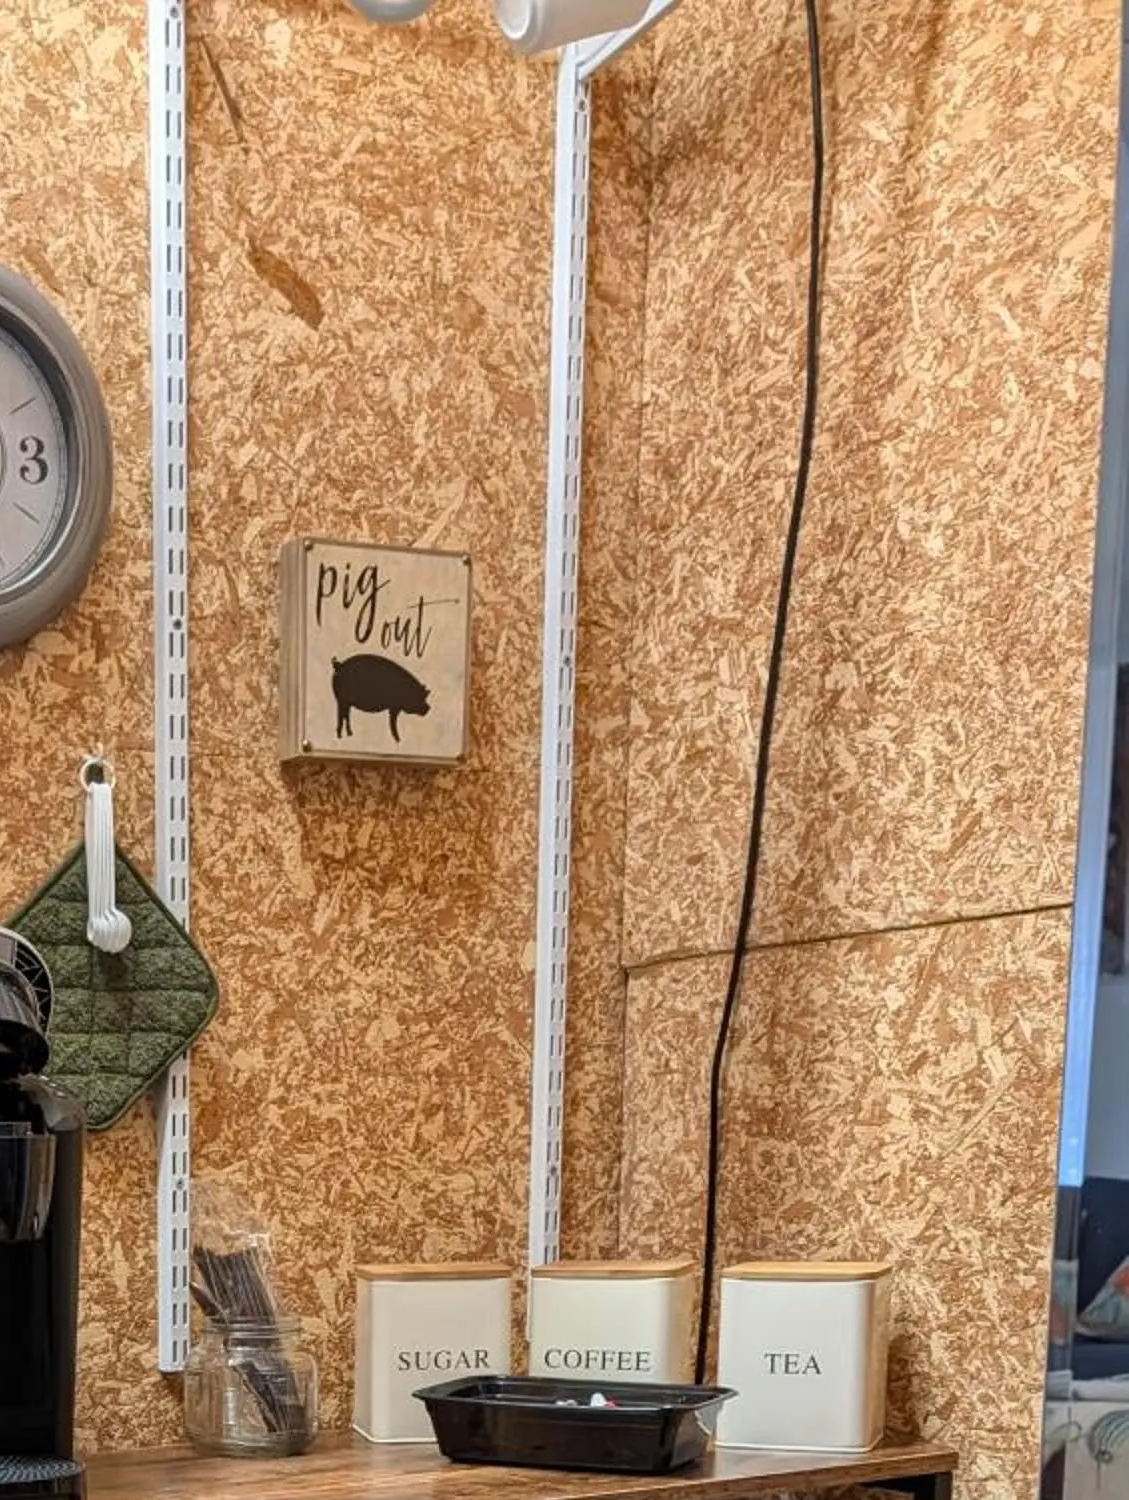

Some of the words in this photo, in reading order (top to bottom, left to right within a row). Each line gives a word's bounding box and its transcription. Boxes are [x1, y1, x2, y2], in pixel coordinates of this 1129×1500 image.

[18, 436, 49, 485] 3
[316, 562, 391, 643] pig
[380, 596, 460, 658] out
[397, 1349, 490, 1372] SUGAR
[544, 1348, 651, 1373] COFFEE
[764, 1353, 822, 1376] TEA
